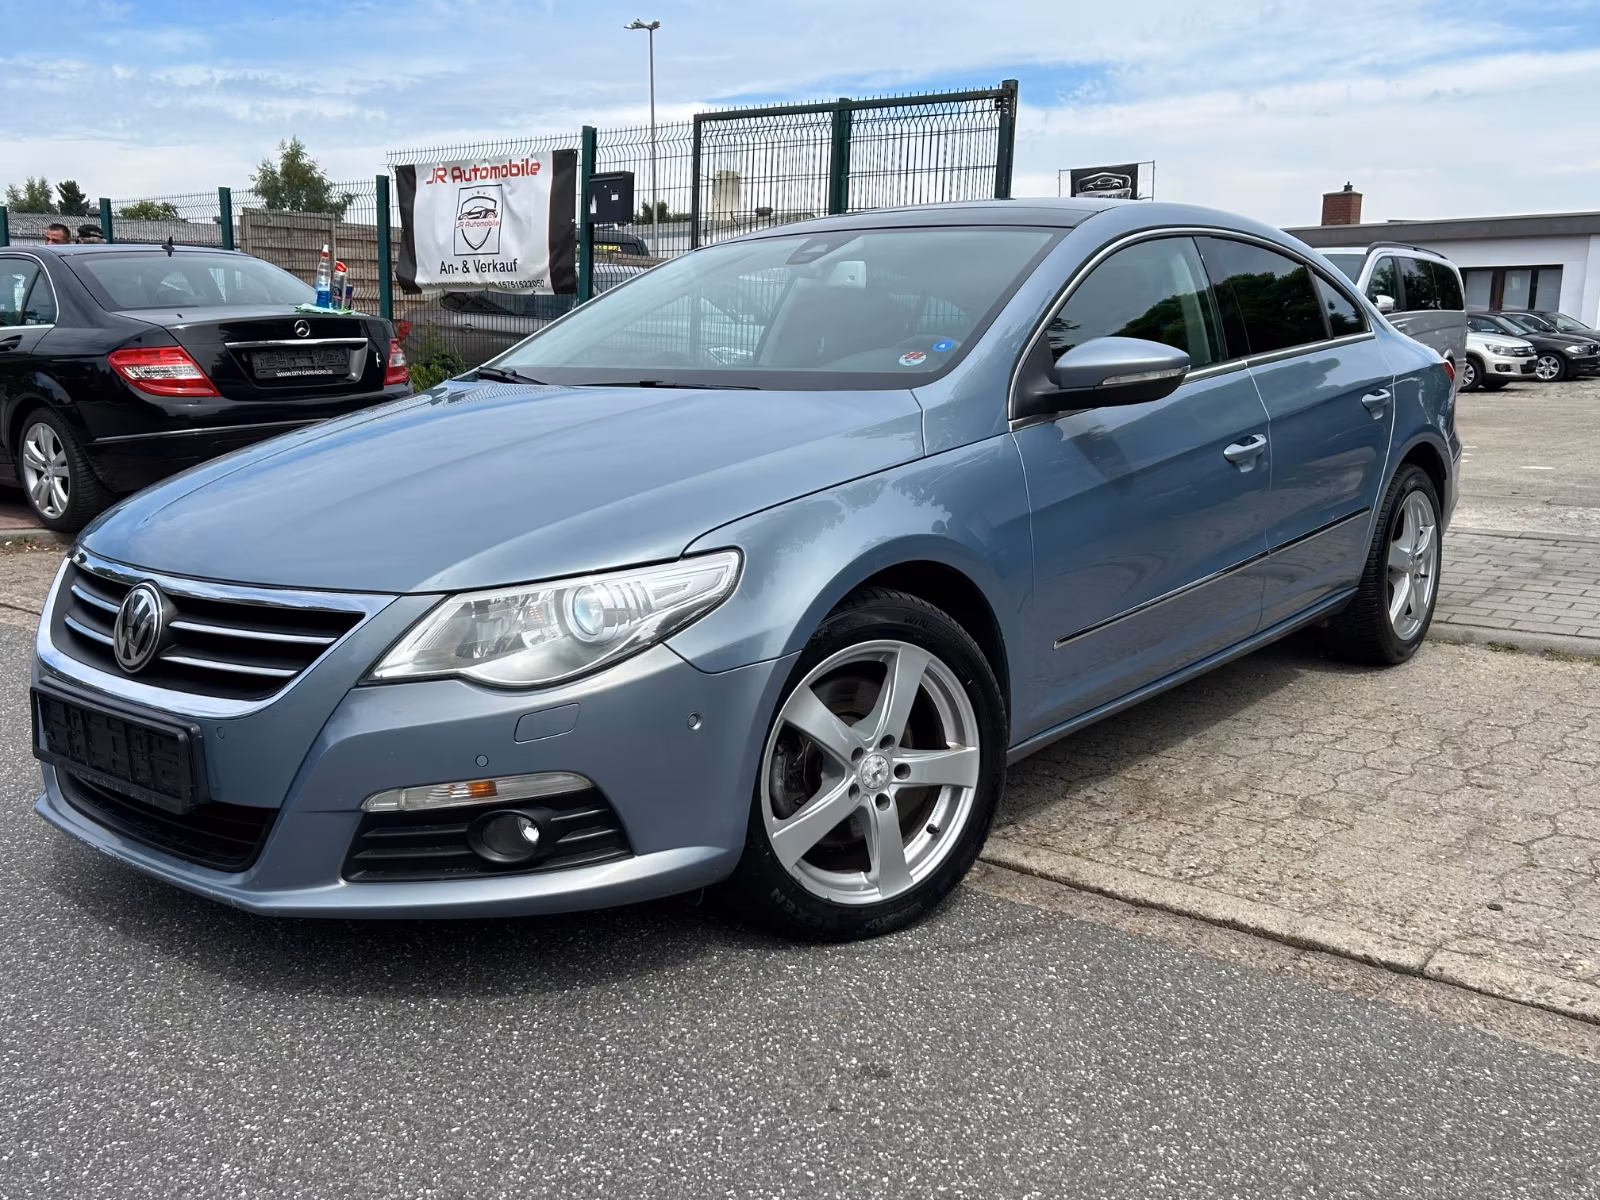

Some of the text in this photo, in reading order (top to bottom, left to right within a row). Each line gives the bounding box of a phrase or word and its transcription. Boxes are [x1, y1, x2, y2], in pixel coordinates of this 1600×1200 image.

[426, 158, 541, 185] JR Automobile
[465, 220, 499, 228] Automobile
[439, 258, 518, 275] An- & Verkauf
